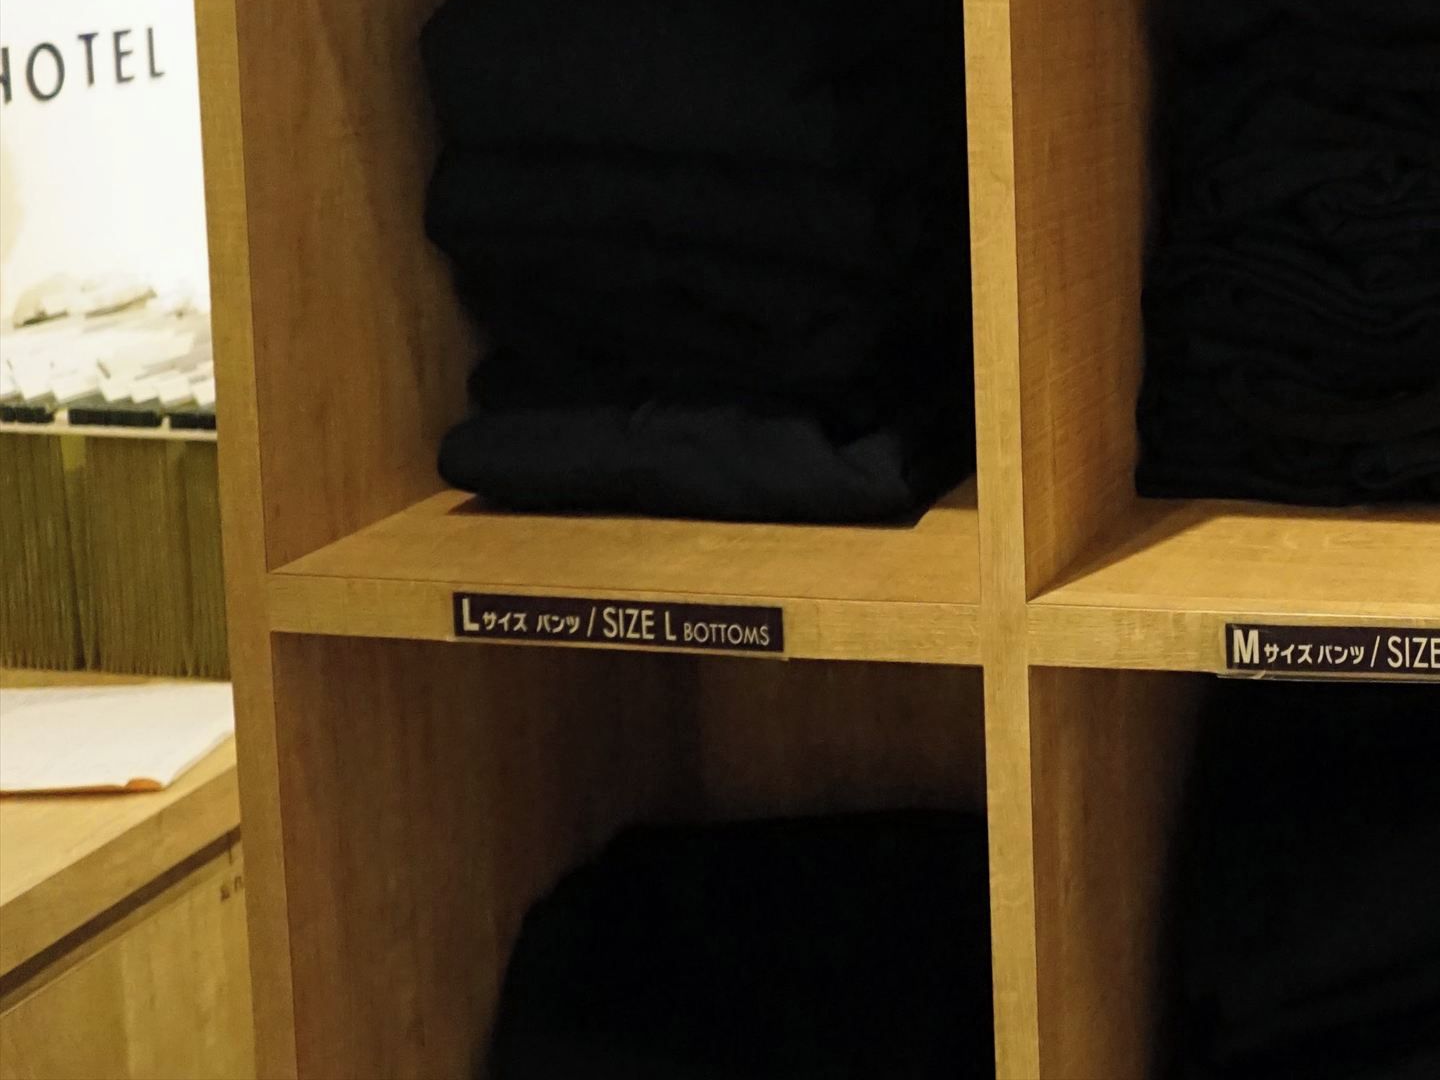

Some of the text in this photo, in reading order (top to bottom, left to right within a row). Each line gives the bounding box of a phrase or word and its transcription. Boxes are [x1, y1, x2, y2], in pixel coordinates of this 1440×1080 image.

[536, 613, 580, 635] パンツ
[603, 607, 655, 640] SIZE
[664, 611, 677, 641] L
[683, 622, 770, 646] BOTTOMS
[1318, 642, 1365, 664] パンツ
